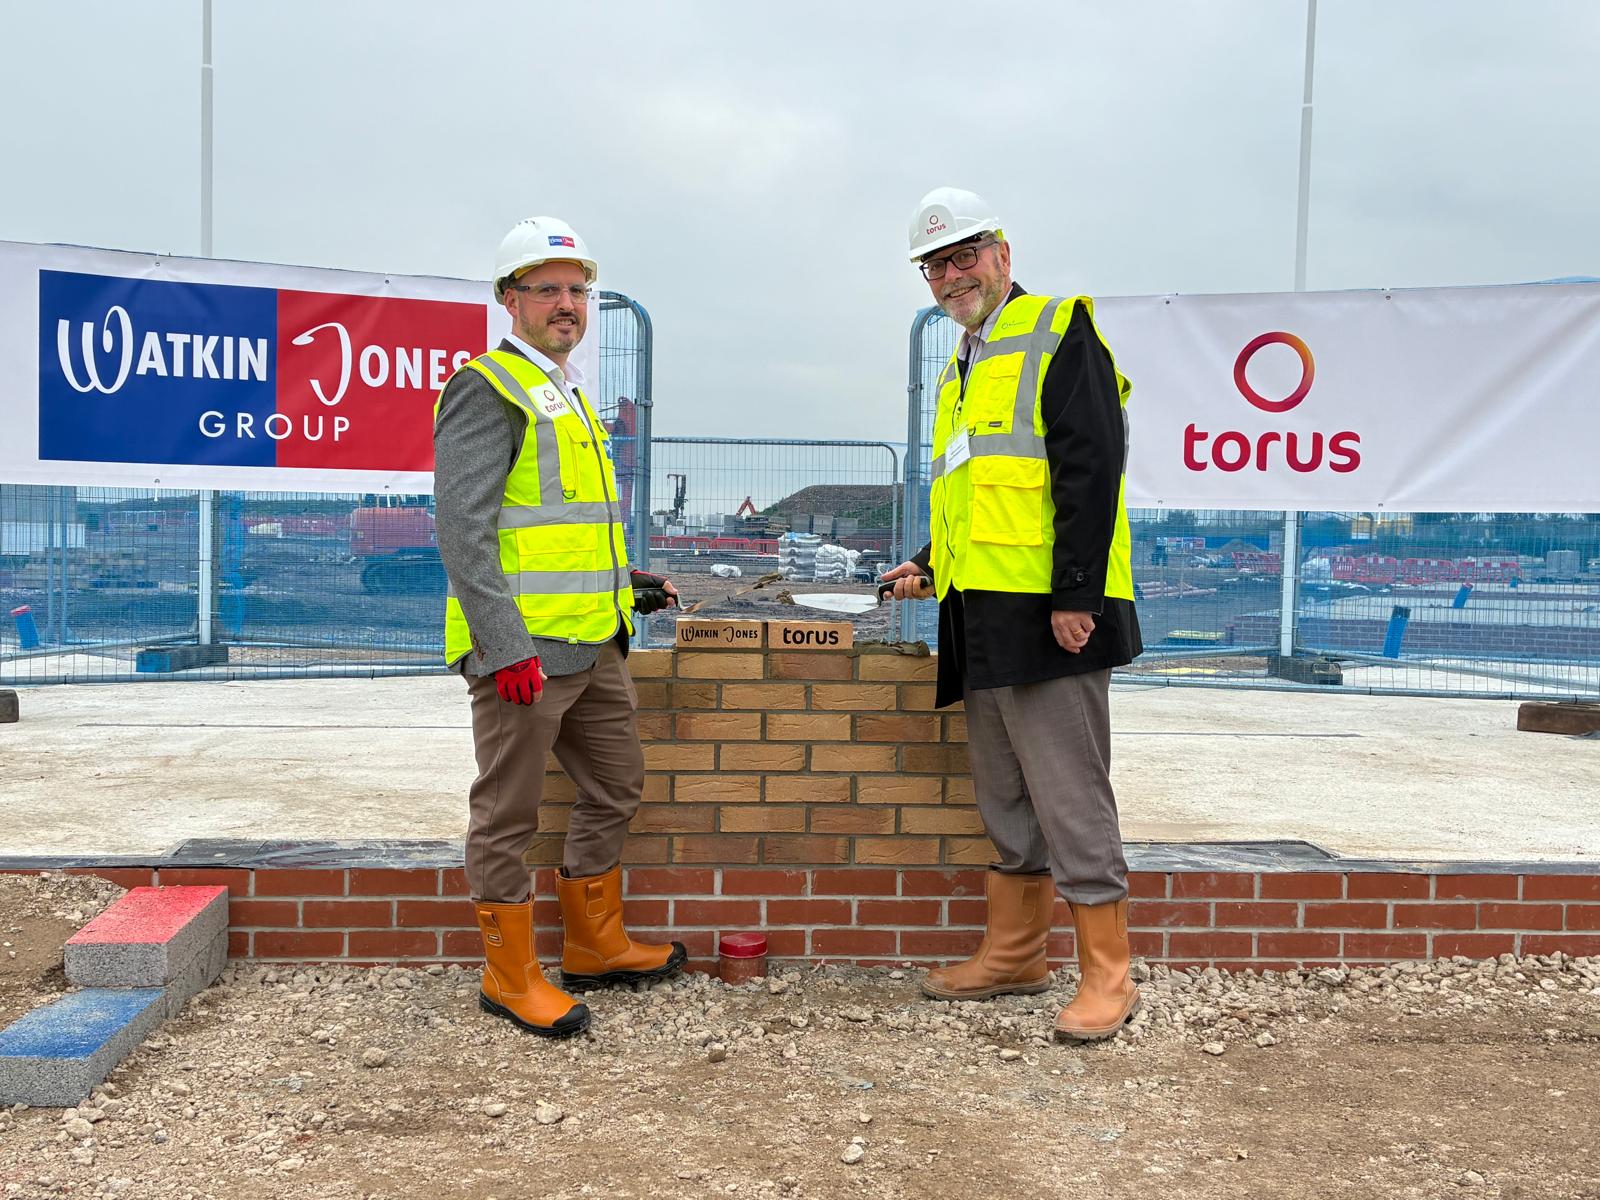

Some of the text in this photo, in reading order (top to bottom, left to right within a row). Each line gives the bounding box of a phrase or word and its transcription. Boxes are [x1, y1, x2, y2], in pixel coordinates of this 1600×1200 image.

[926, 224, 946, 235] torus
[57, 305, 268, 394] WATKIN
[545, 402, 565, 413] torus
[199, 410, 350, 441] GROUP
[1183, 423, 1361, 473] torus
[681, 626, 758, 642] WATKIN JONES
[783, 627, 839, 645] torus
